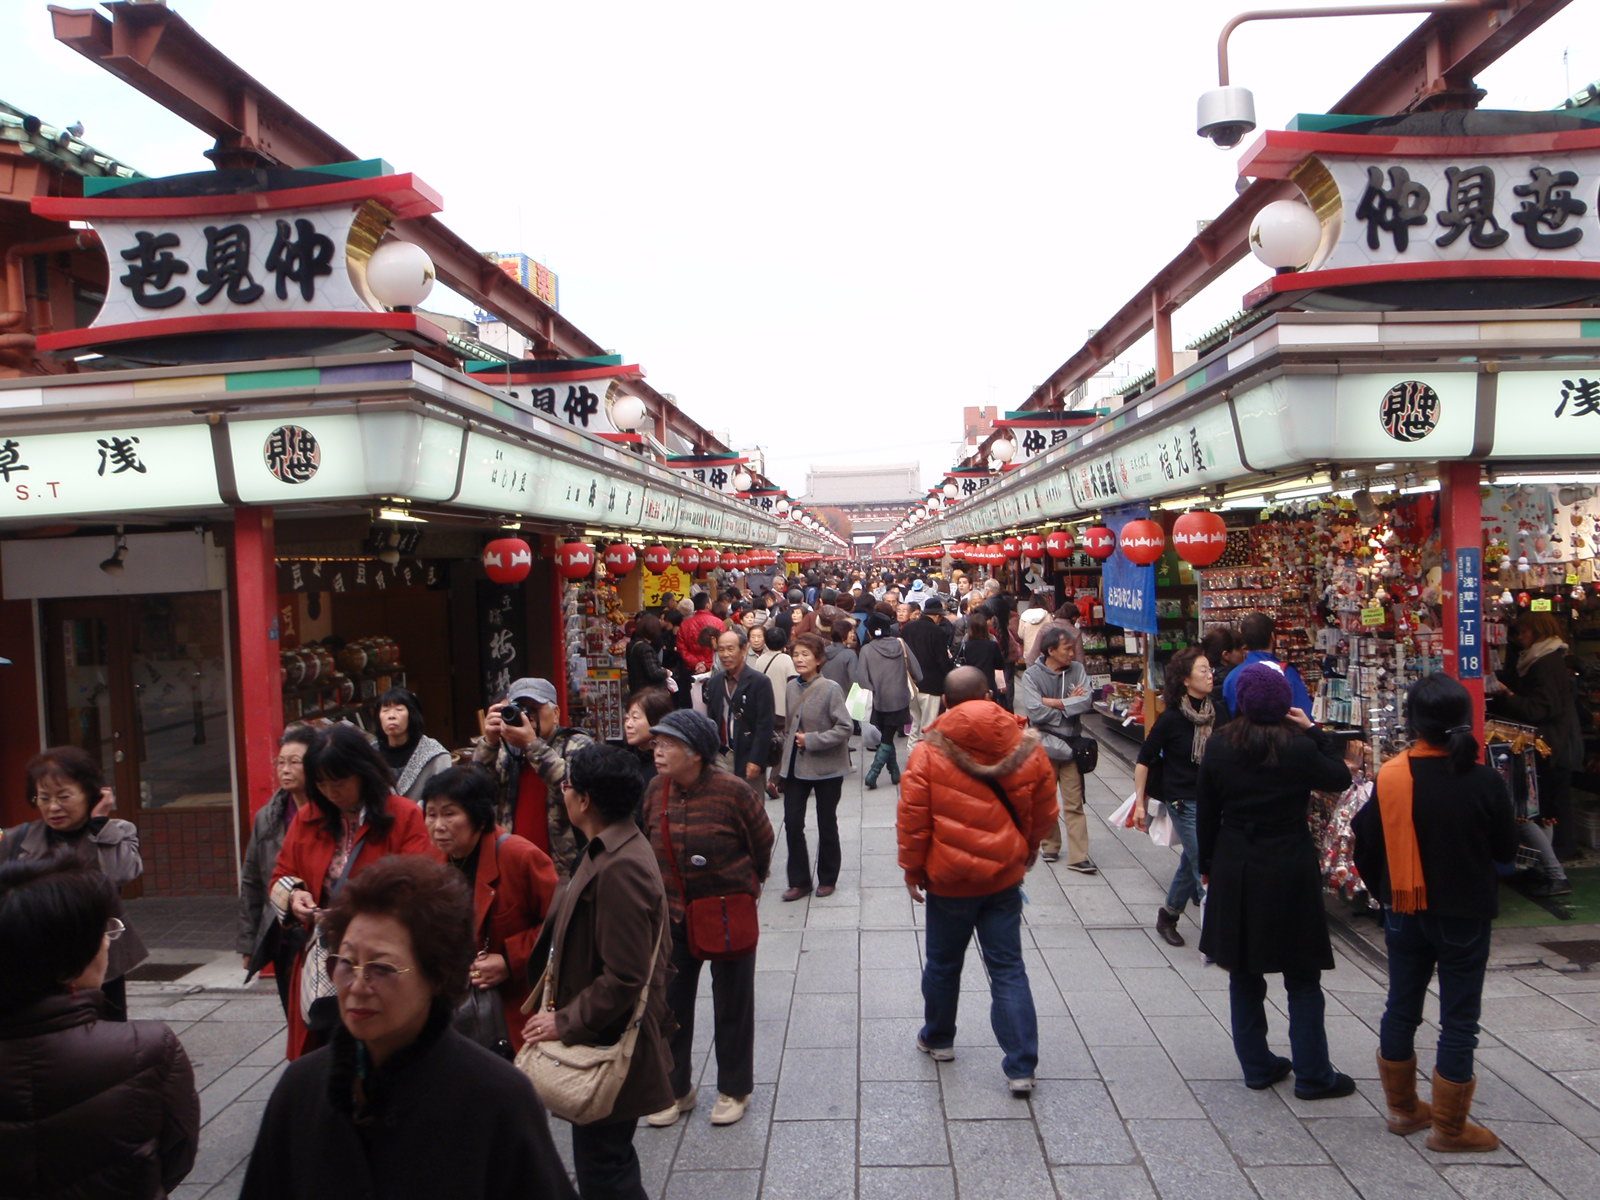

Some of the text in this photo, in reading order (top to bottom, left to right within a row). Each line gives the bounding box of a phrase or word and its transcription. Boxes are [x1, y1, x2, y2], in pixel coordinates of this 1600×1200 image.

[1355, 165, 1587, 253] 仲見世
[1461, 656, 1479, 670] 18
